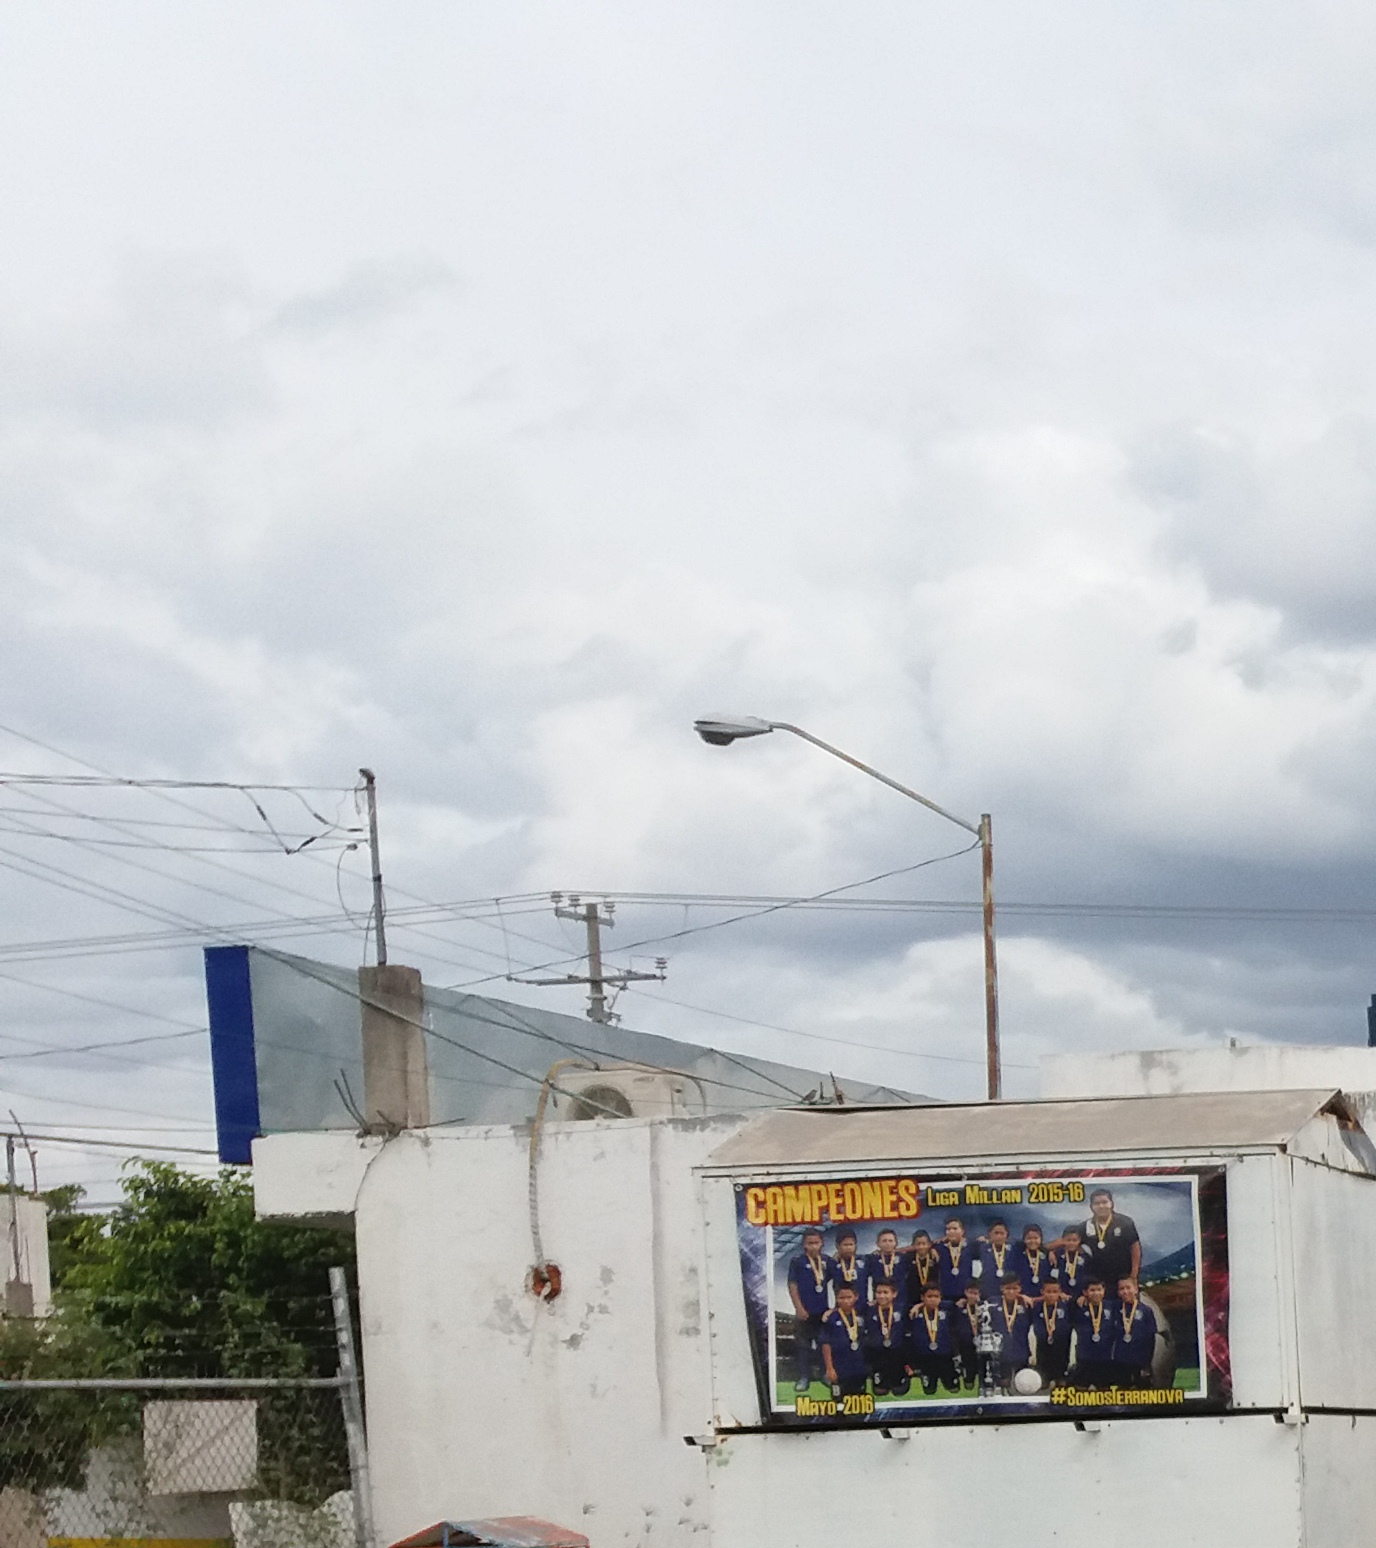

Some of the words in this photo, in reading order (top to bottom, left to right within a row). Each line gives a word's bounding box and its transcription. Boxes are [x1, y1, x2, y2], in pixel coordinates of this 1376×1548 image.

[746, 1179, 919, 1225] CAMPEONES
[1028, 1181, 1085, 1203] 2015-16
[842, 1394, 875, 1415] 2016
